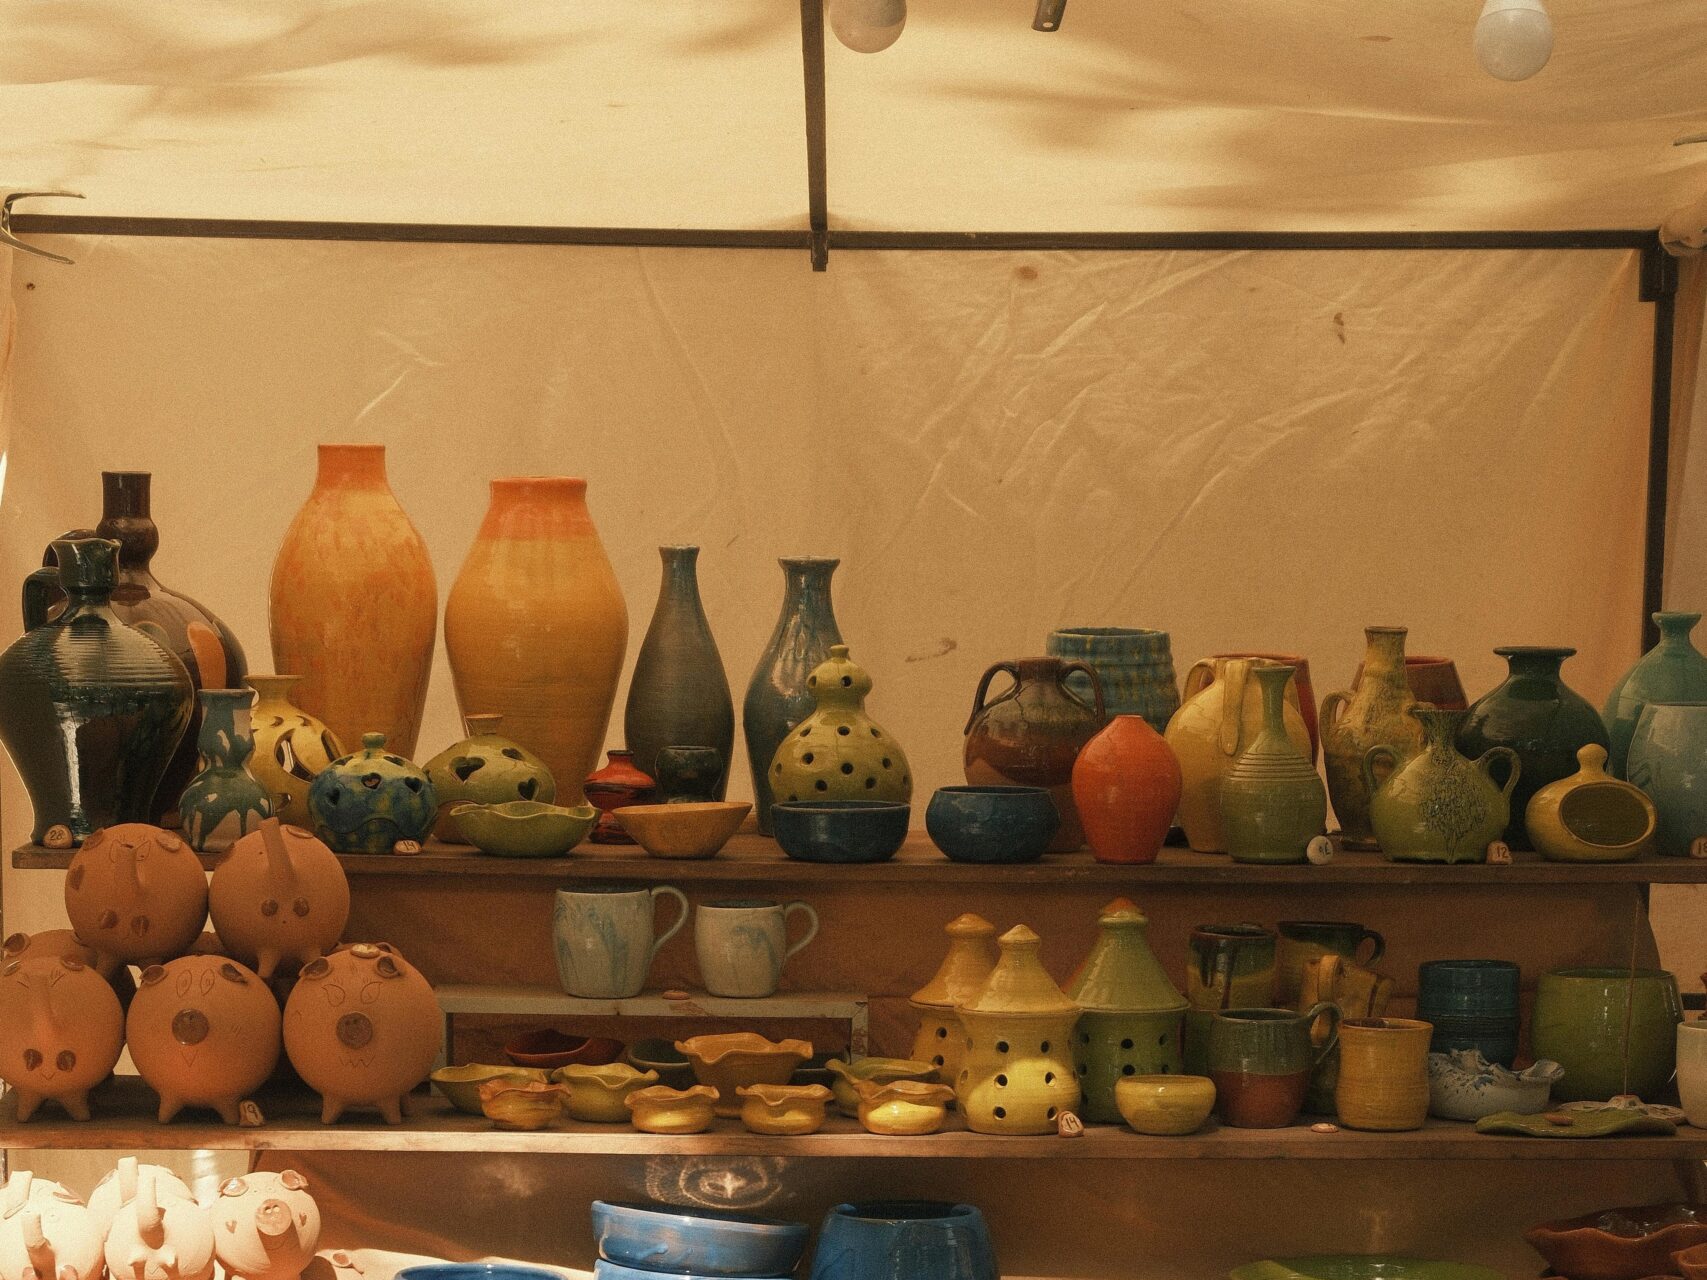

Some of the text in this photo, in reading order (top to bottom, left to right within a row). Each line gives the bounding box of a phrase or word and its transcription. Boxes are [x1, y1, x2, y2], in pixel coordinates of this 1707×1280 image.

[50, 830, 63, 841] 28
[1496, 845, 1509, 859] 12
[1065, 1116, 1080, 1130] 14
